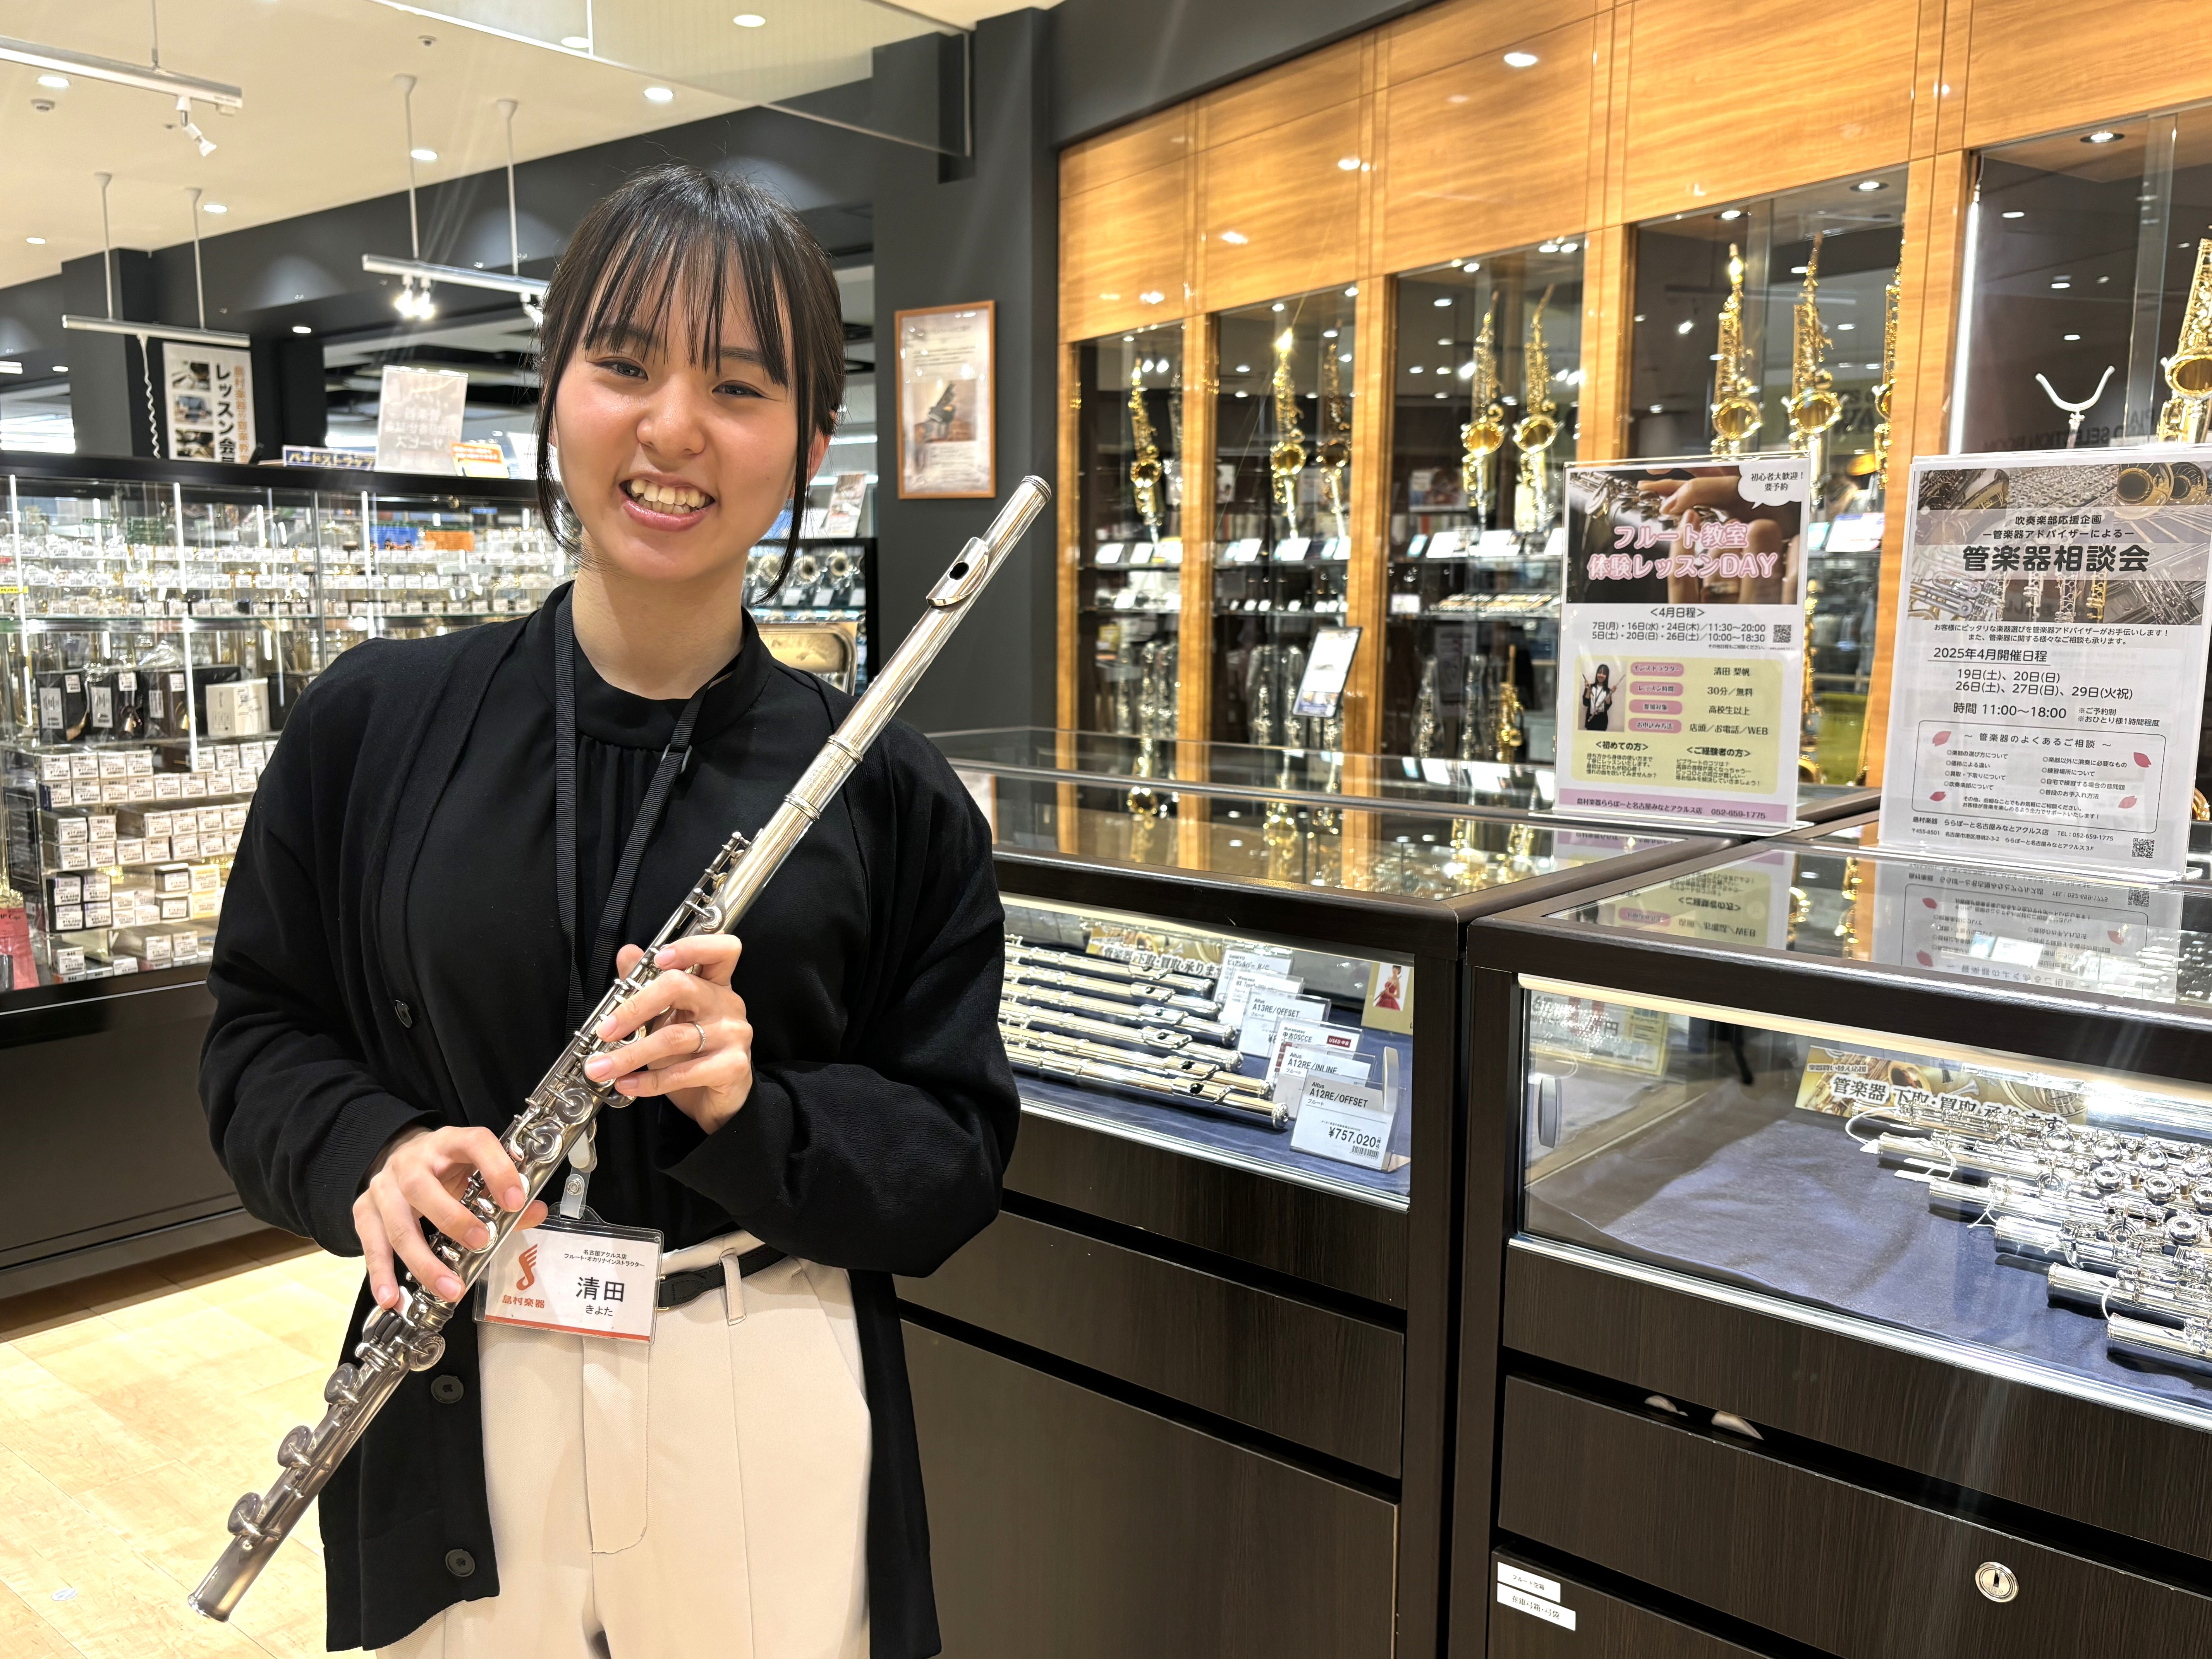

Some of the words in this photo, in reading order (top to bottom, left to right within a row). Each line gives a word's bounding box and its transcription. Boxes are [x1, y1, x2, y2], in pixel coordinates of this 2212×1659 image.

[1750, 471, 1803, 481] 初心者大歓迎！
[1765, 483, 1788, 491] 要予約
[2015, 515, 2102, 526] 吹奏楽部応援企画
[1614, 522, 1749, 550] フルート教室
[1962, 544, 2150, 572] 管楽器相談会
[1587, 552, 1778, 580] 体験レッスンDAY
[1934, 624, 2169, 637] お客様にピッタリな楽器選びを管楽器アドバイザーがお手伝いします！
[1968, 634, 2127, 646] また、管楽器に関する様々なご相談も承ります。
[1934, 647, 2048, 663] 2025年4月開催日程
[1714, 667, 1730, 676] 清田
[1958, 669, 2060, 684] 19日(土)、20日(日)
[1709, 705, 1750, 716] 高校生以上
[1953, 702, 1977, 715] 時間
[1982, 704, 2067, 719] 11:00～18:00
[1711, 809, 1766, 819] 052-659-1775
[1912, 816, 1938, 824] 島村楽器
[1944, 819, 2049, 836] ららぽーと名古屋みなとアクルス店
[1252, 1004, 1300, 1018] A13RE/OFFSET
[1833, 1076, 1886, 1102] 管楽器
[1307, 1098, 1324, 1106] フルート
[1309, 1088, 1368, 1108] A12RE/OFFSET
[1328, 1126, 1376, 1148] ¥757,020
[564, 1253, 645, 1267] フルート・オカリナインストラクター
[583, 1249, 627, 1259] 名古屋アクルス店
[575, 1276, 625, 1302] 清田
[502, 1295, 545, 1309] 島村楽器
[585, 1304, 613, 1317] きよた
